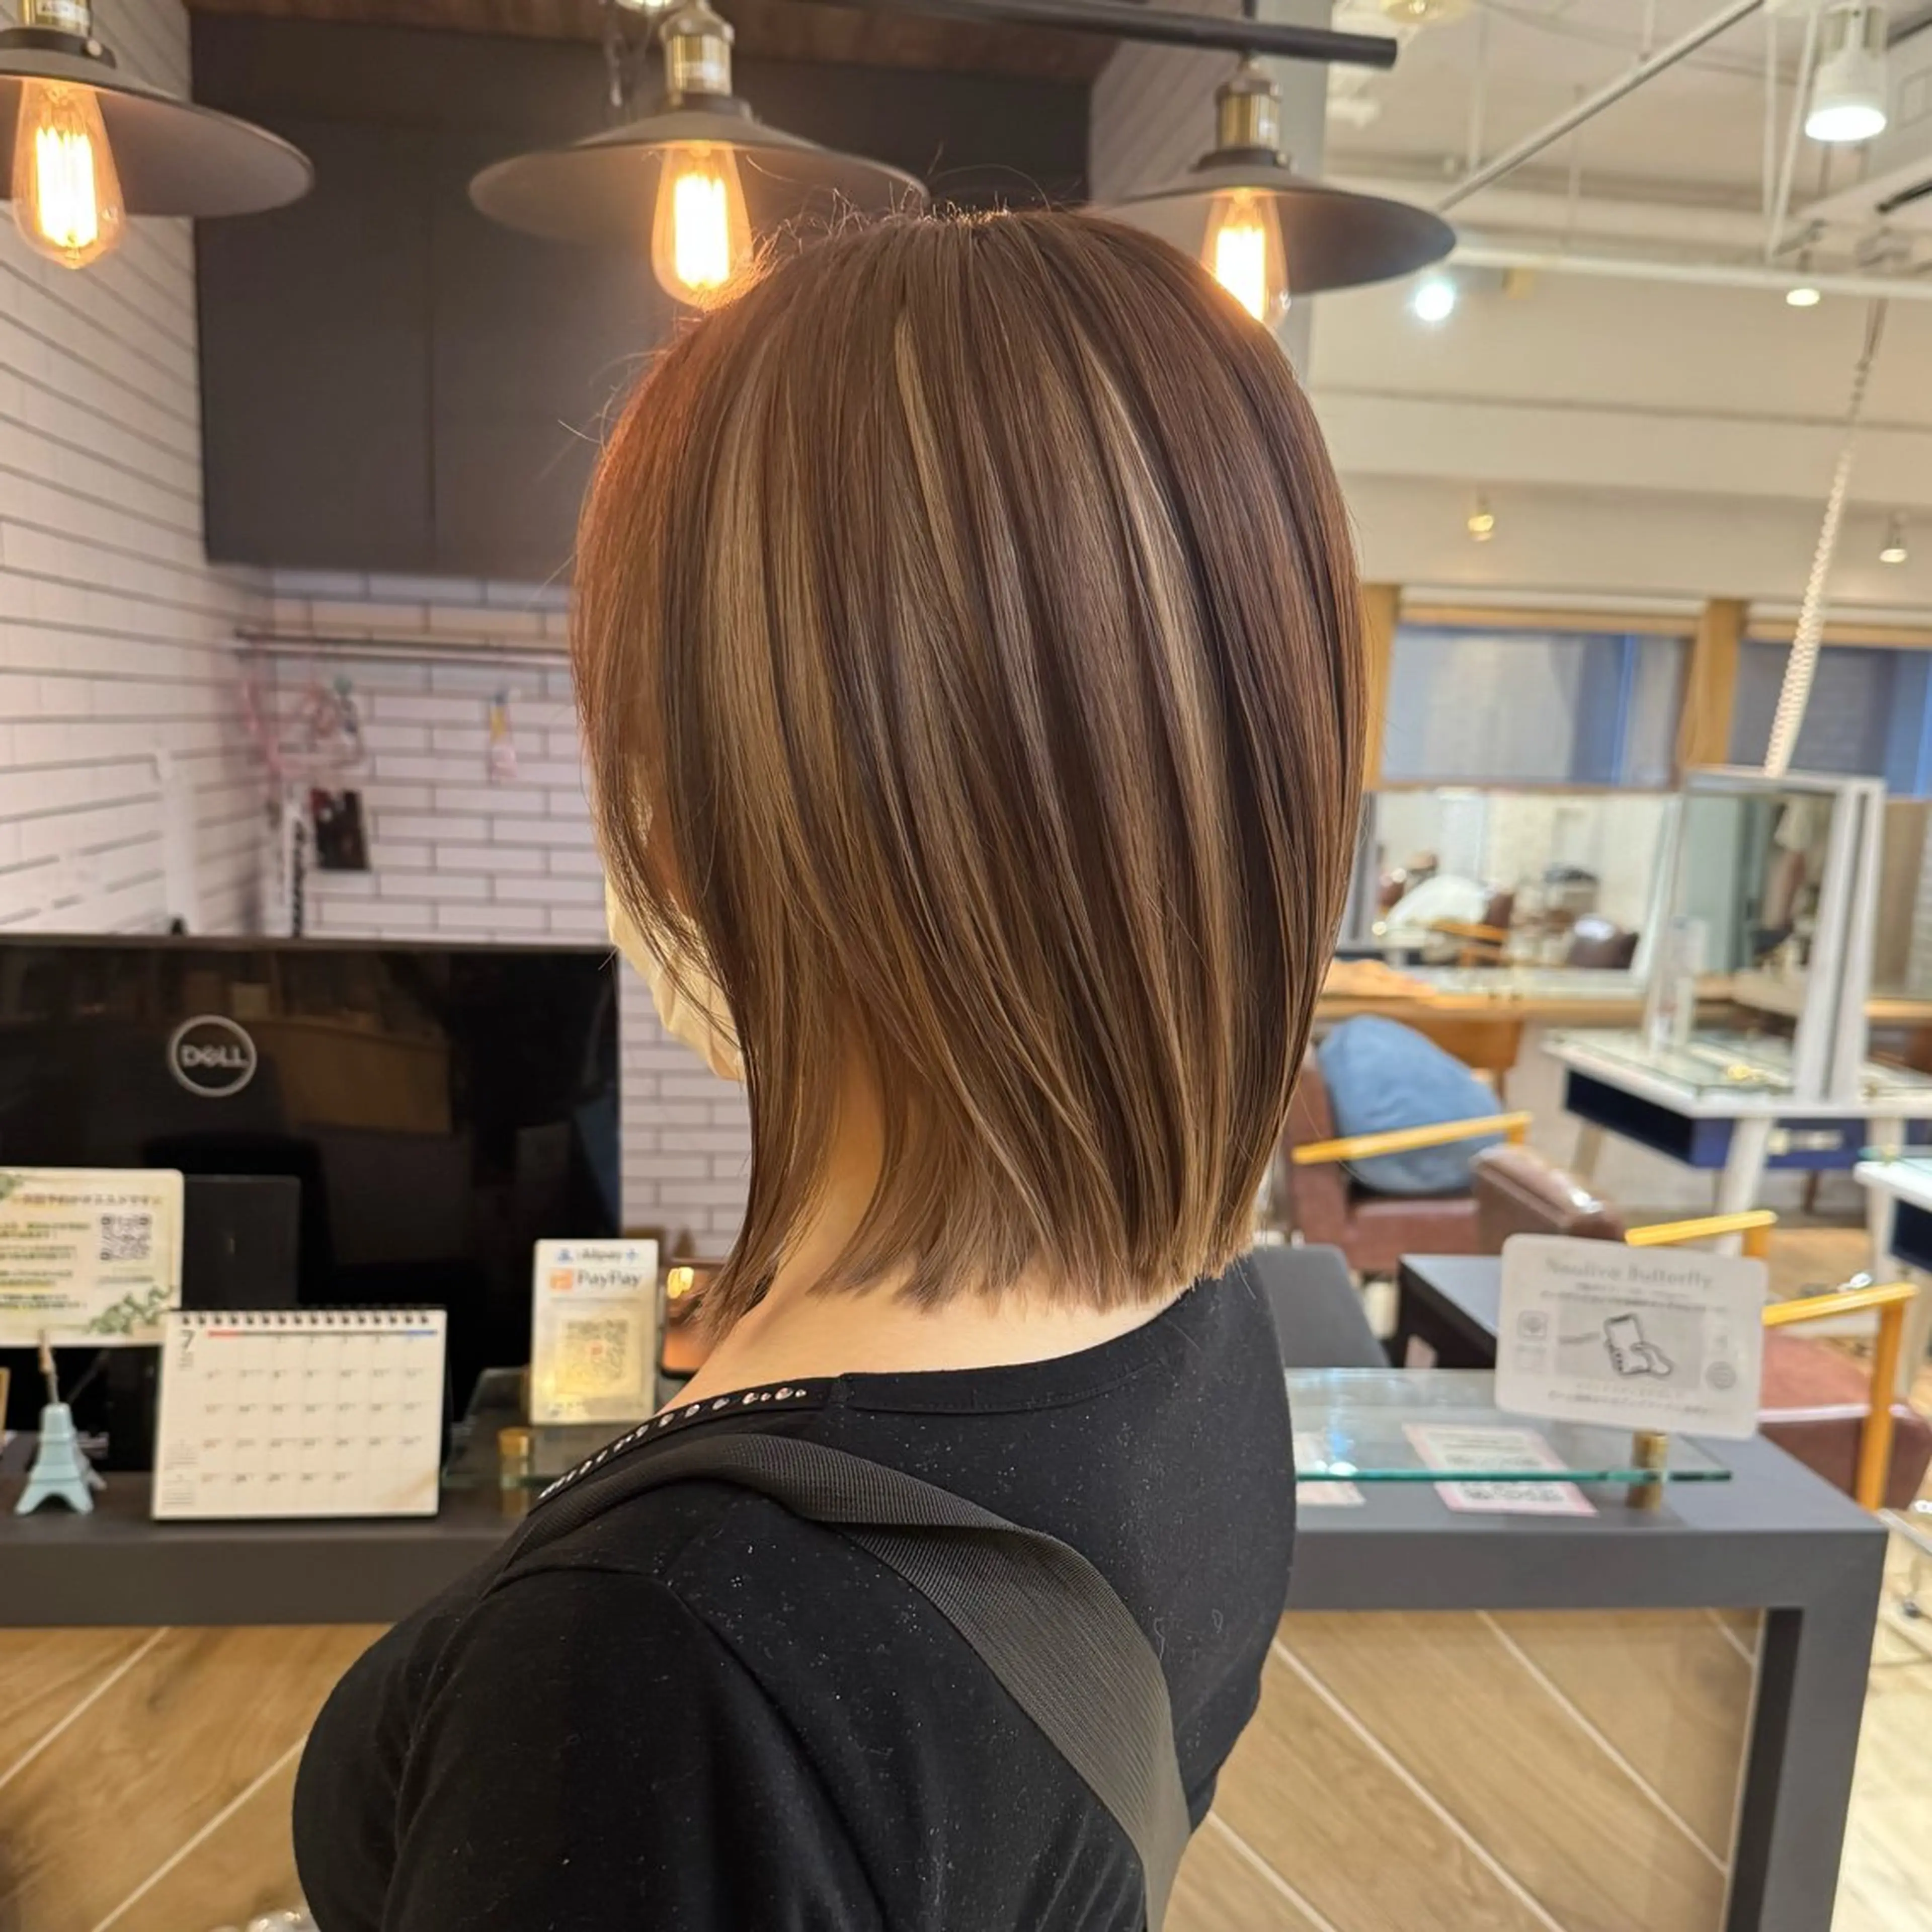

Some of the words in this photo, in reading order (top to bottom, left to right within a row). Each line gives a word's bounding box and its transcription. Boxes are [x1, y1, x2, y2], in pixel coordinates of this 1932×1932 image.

[182, 1044, 251, 1068] DELL
[577, 1269, 642, 1289] PayPay
[180, 1329, 196, 1349] 7
